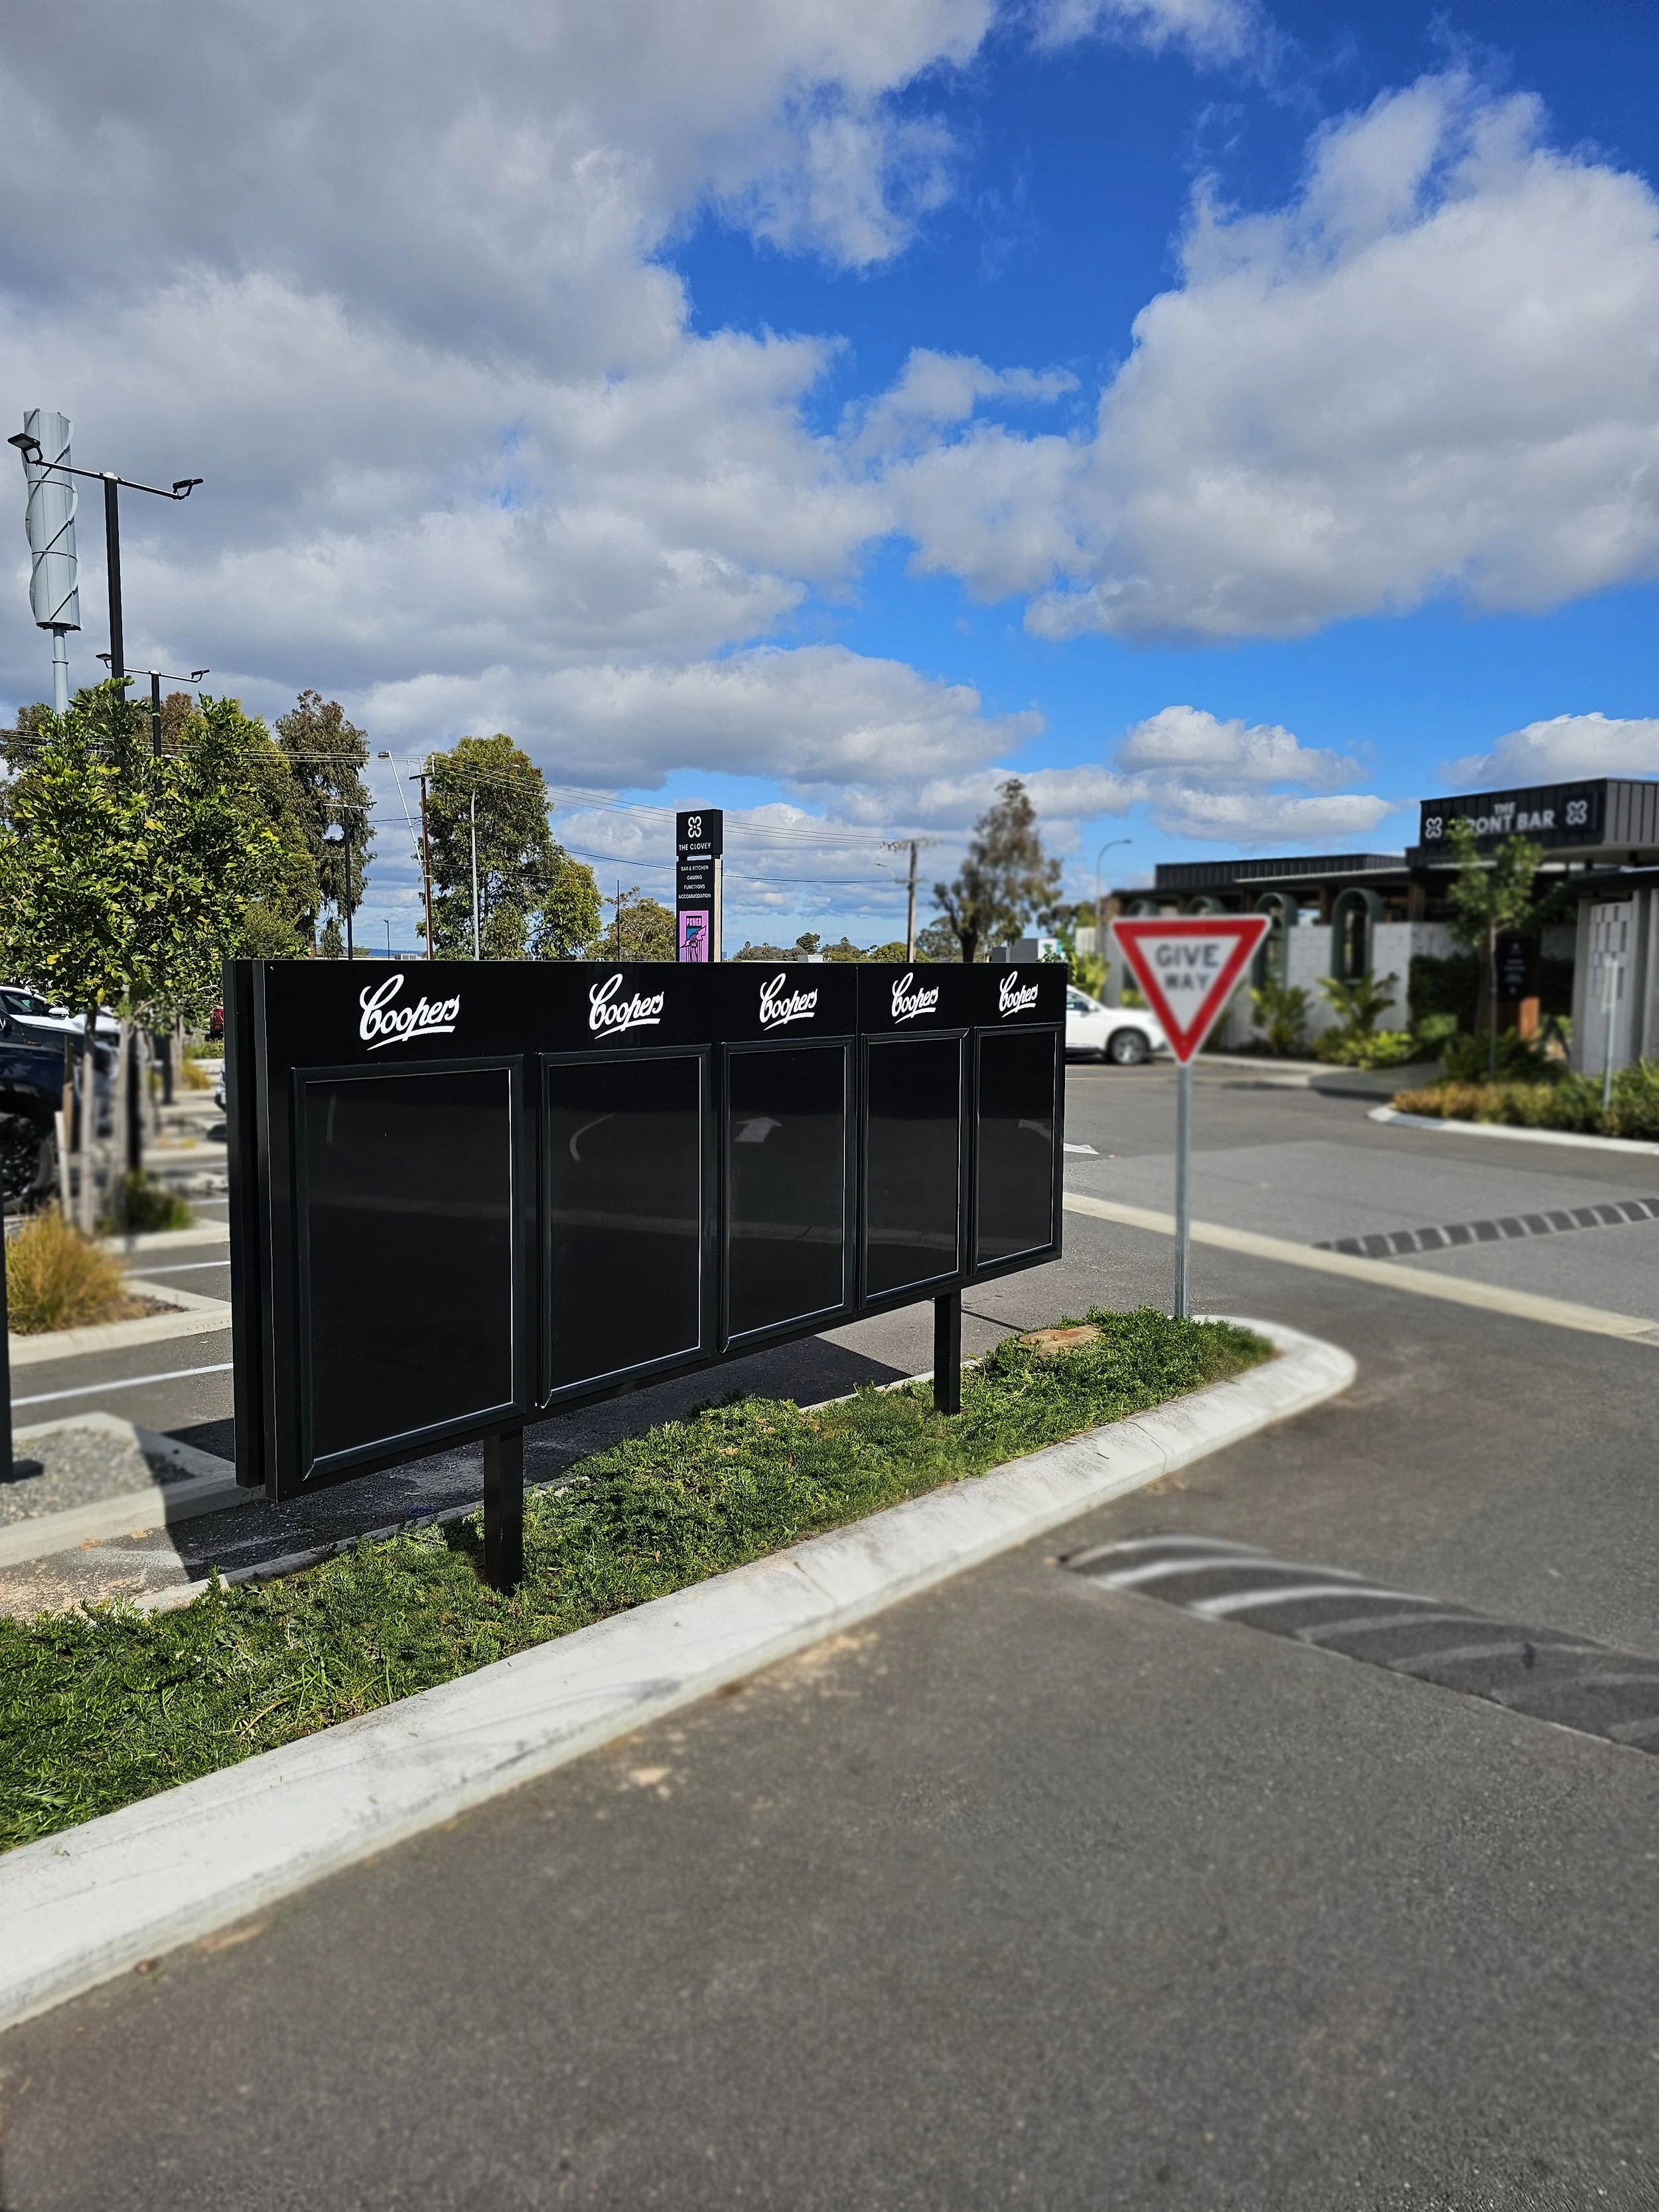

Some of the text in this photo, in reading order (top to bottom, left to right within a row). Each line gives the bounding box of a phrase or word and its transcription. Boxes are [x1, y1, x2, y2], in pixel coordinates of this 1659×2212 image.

[1494, 802, 1516, 815] THE
[1516, 810, 1555, 830] BAR
[1155, 944, 1219, 968] GIVE
[760, 973, 818, 1031] Coopers
[892, 972, 938, 1023] Coopers
[999, 971, 1038, 1017] Coopers
[1165, 974, 1210, 990] WAY
[360, 974, 460, 1050] Coopers
[589, 974, 664, 1039] Coopers
